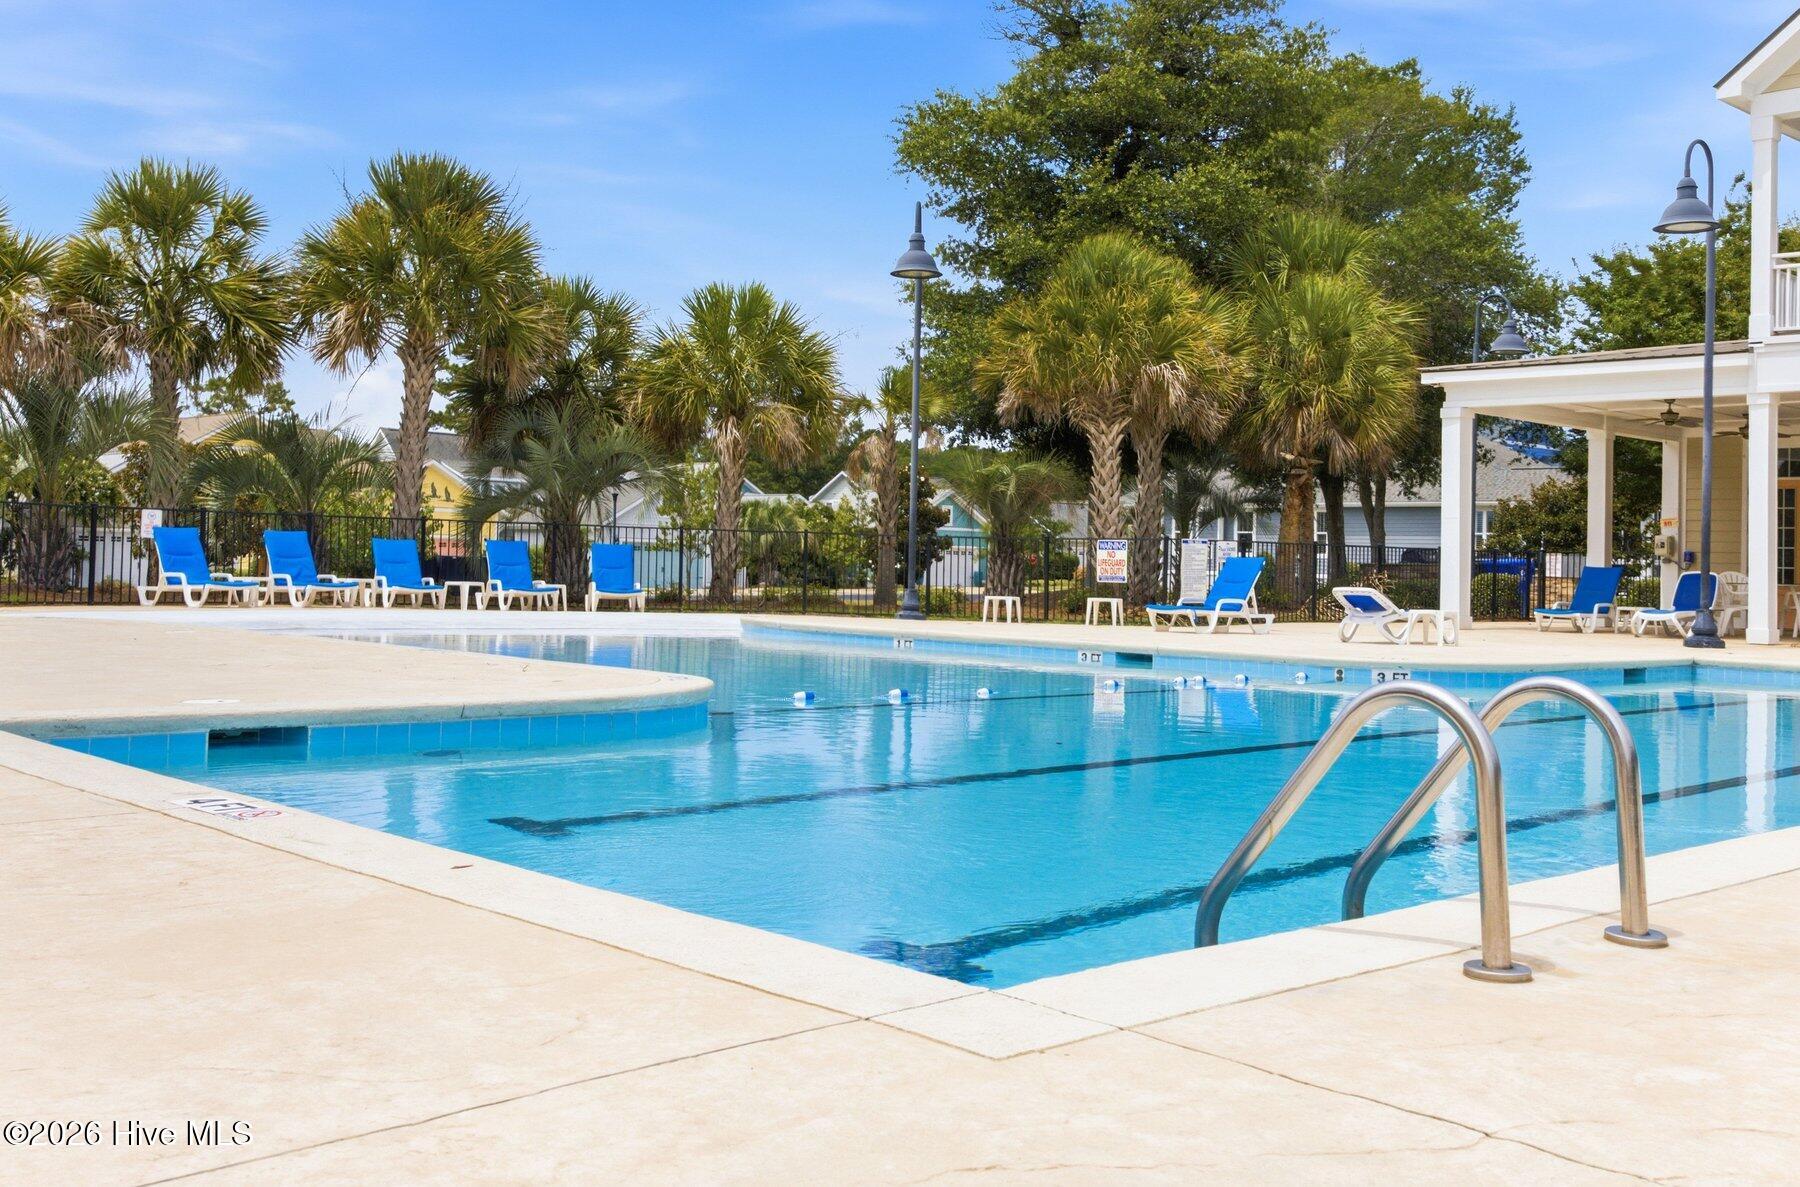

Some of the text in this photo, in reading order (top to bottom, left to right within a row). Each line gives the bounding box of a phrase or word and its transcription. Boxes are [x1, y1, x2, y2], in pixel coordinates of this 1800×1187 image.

[1099, 541, 1126, 550] WARNING
[1106, 550, 1116, 559] NO
[1097, 559, 1126, 567] LIFEGUARD
[1100, 567, 1125, 575] ON DUTY
[1081, 652, 1087, 662] 3
[1377, 672, 1409, 684] 3 FT
[200, 802, 259, 812] FT
